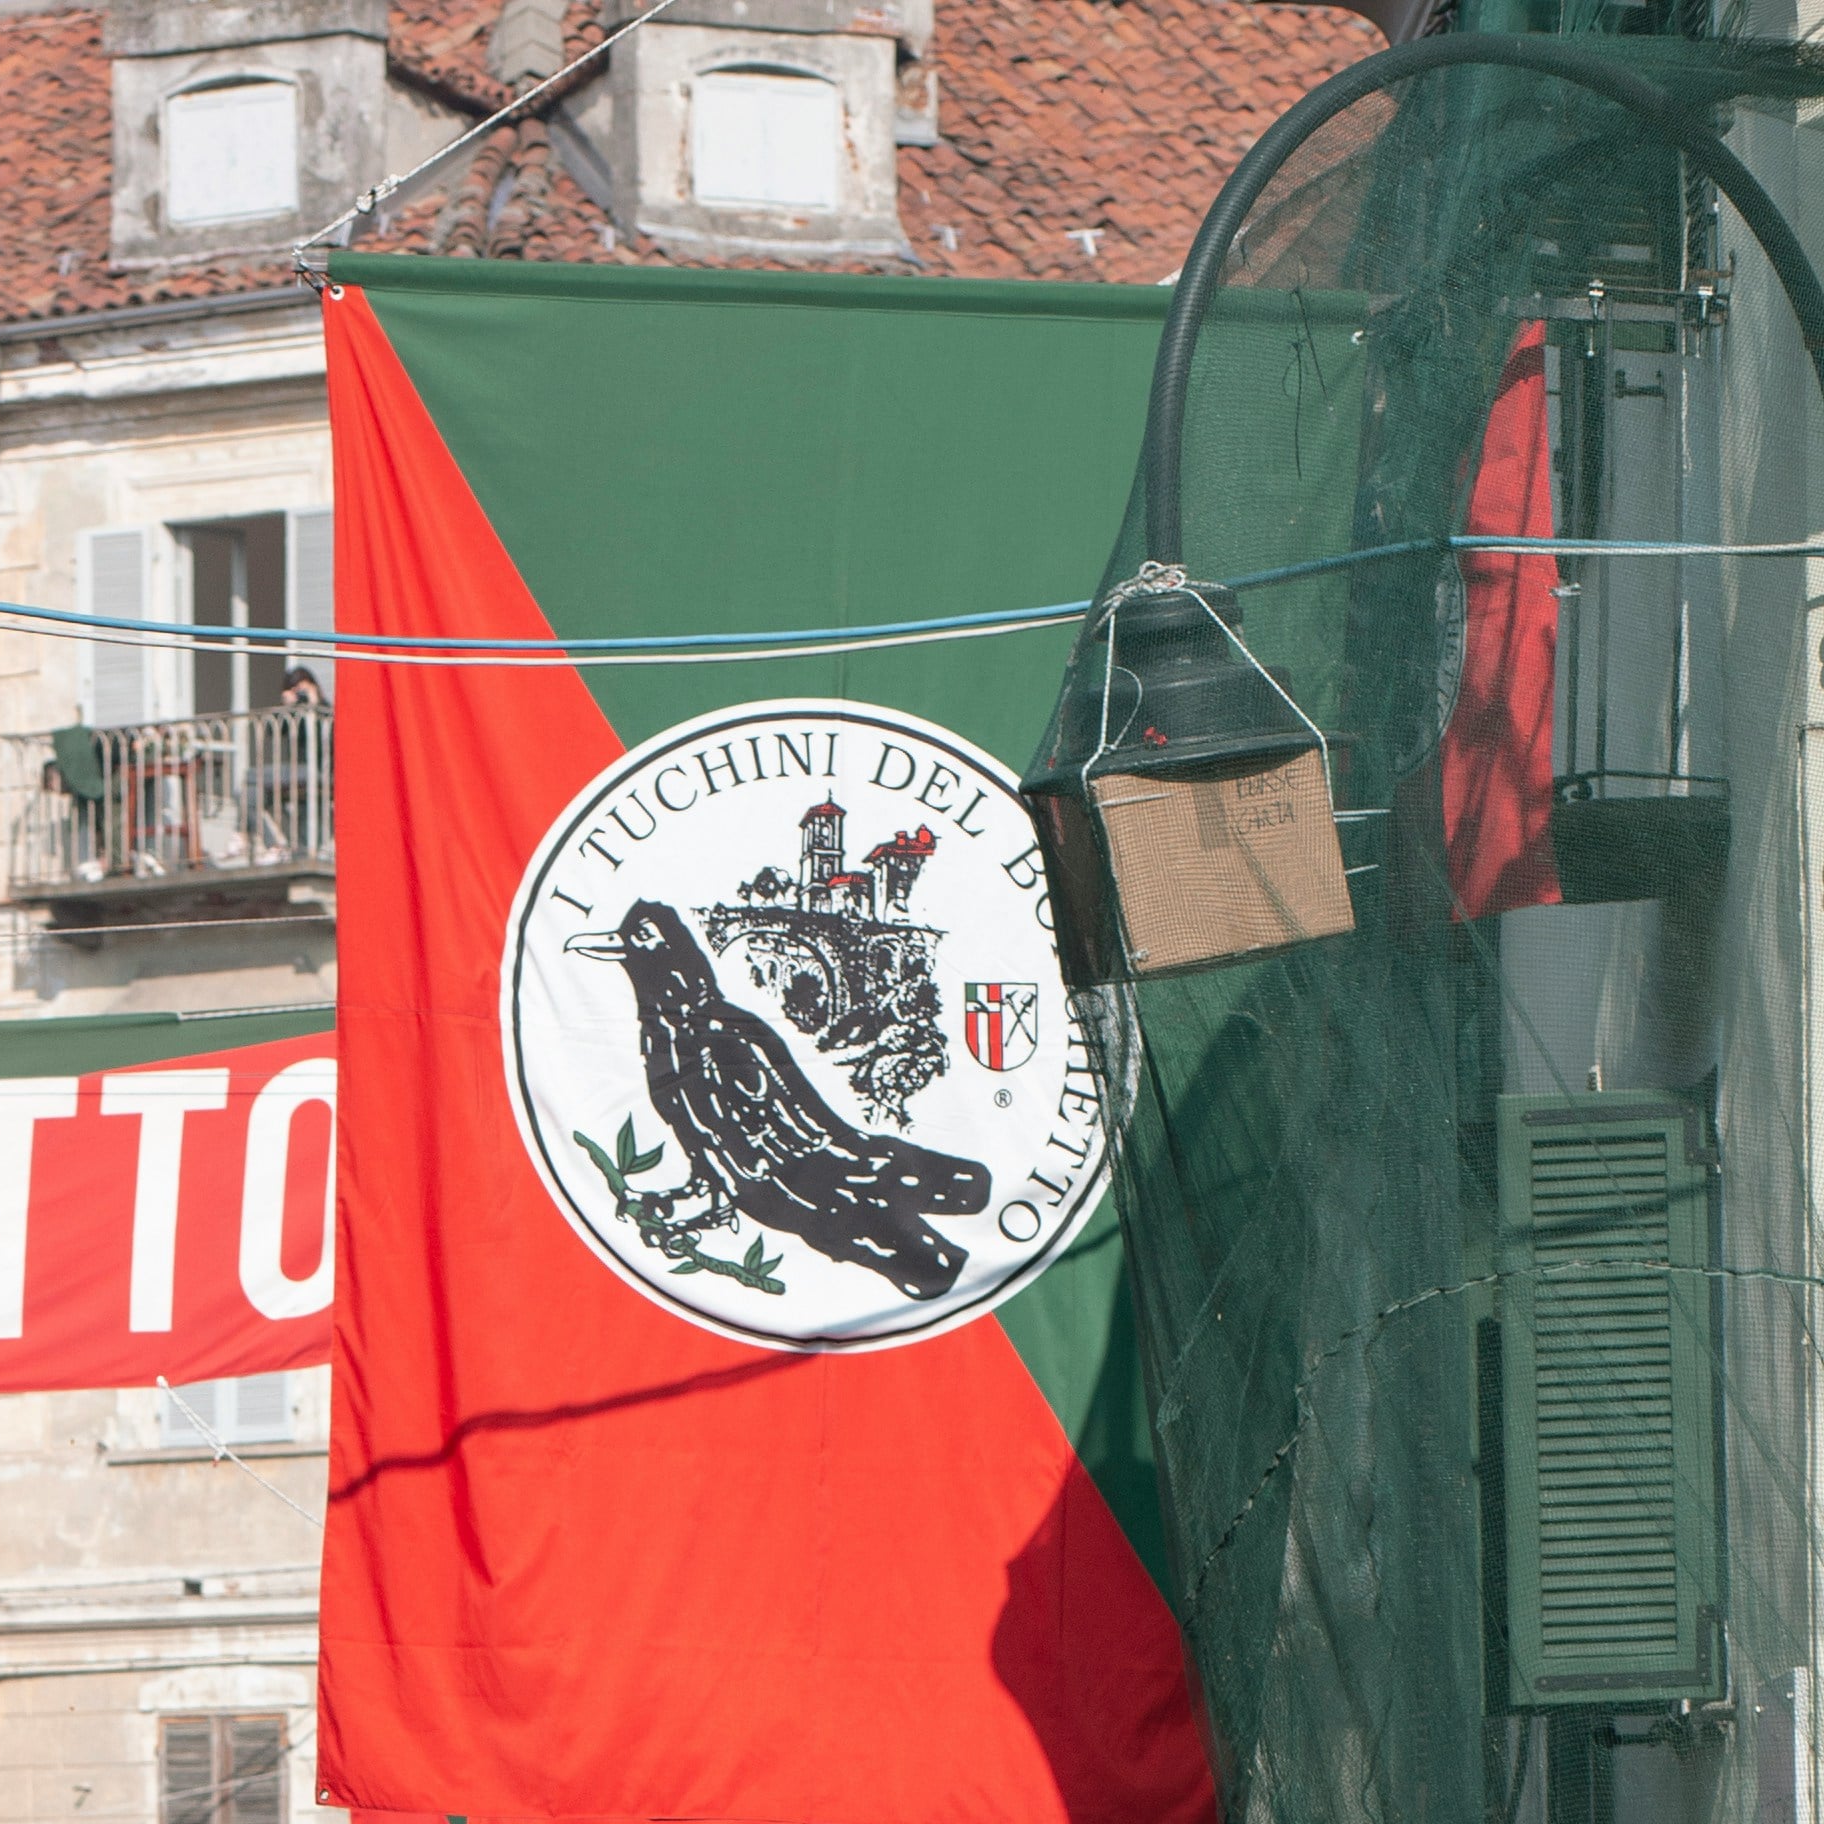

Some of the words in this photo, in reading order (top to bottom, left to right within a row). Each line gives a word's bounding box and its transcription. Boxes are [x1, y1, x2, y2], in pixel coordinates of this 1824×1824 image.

[550, 886, 595, 921] I
[578, 731, 840, 874] TUCHINI
[868, 741, 987, 839] DEL
